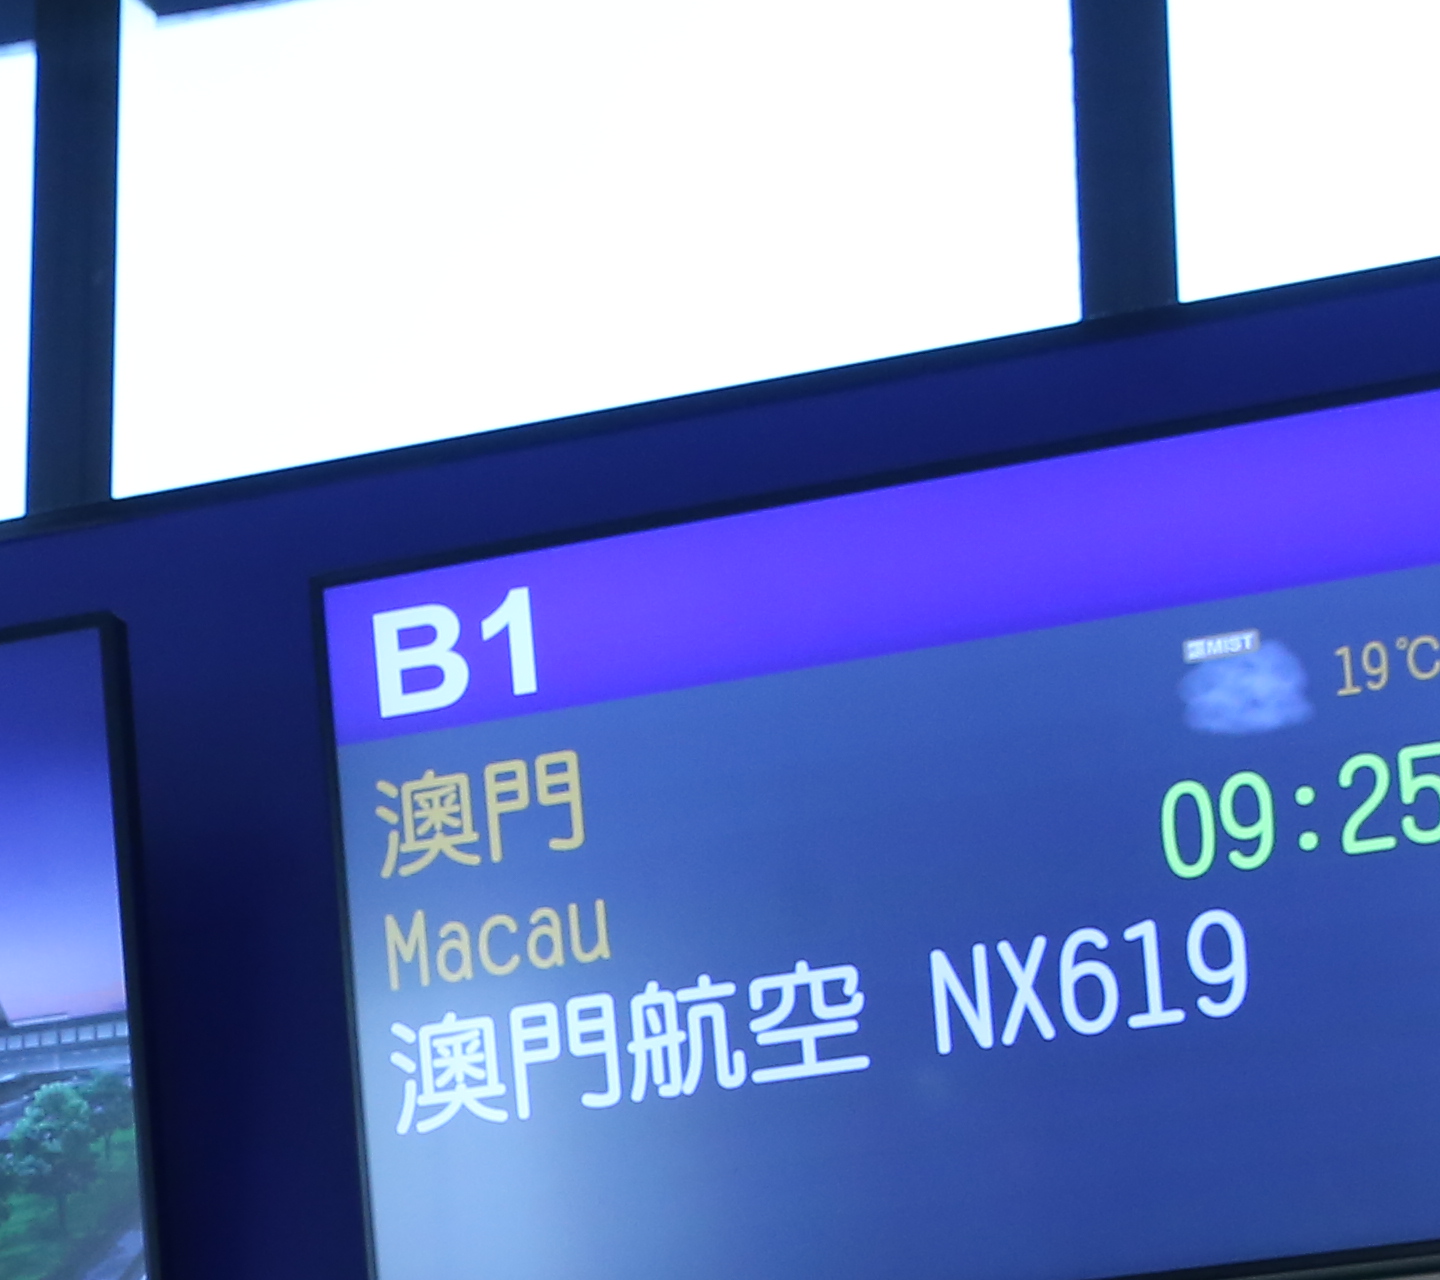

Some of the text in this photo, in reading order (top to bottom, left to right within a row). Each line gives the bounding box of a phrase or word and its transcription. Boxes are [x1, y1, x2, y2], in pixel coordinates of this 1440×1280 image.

[372, 586, 538, 719] B1
[375, 750, 585, 879] 澳門
[384, 898, 611, 991] Macau
[390, 908, 1249, 1136] 澳門航空 NX619
